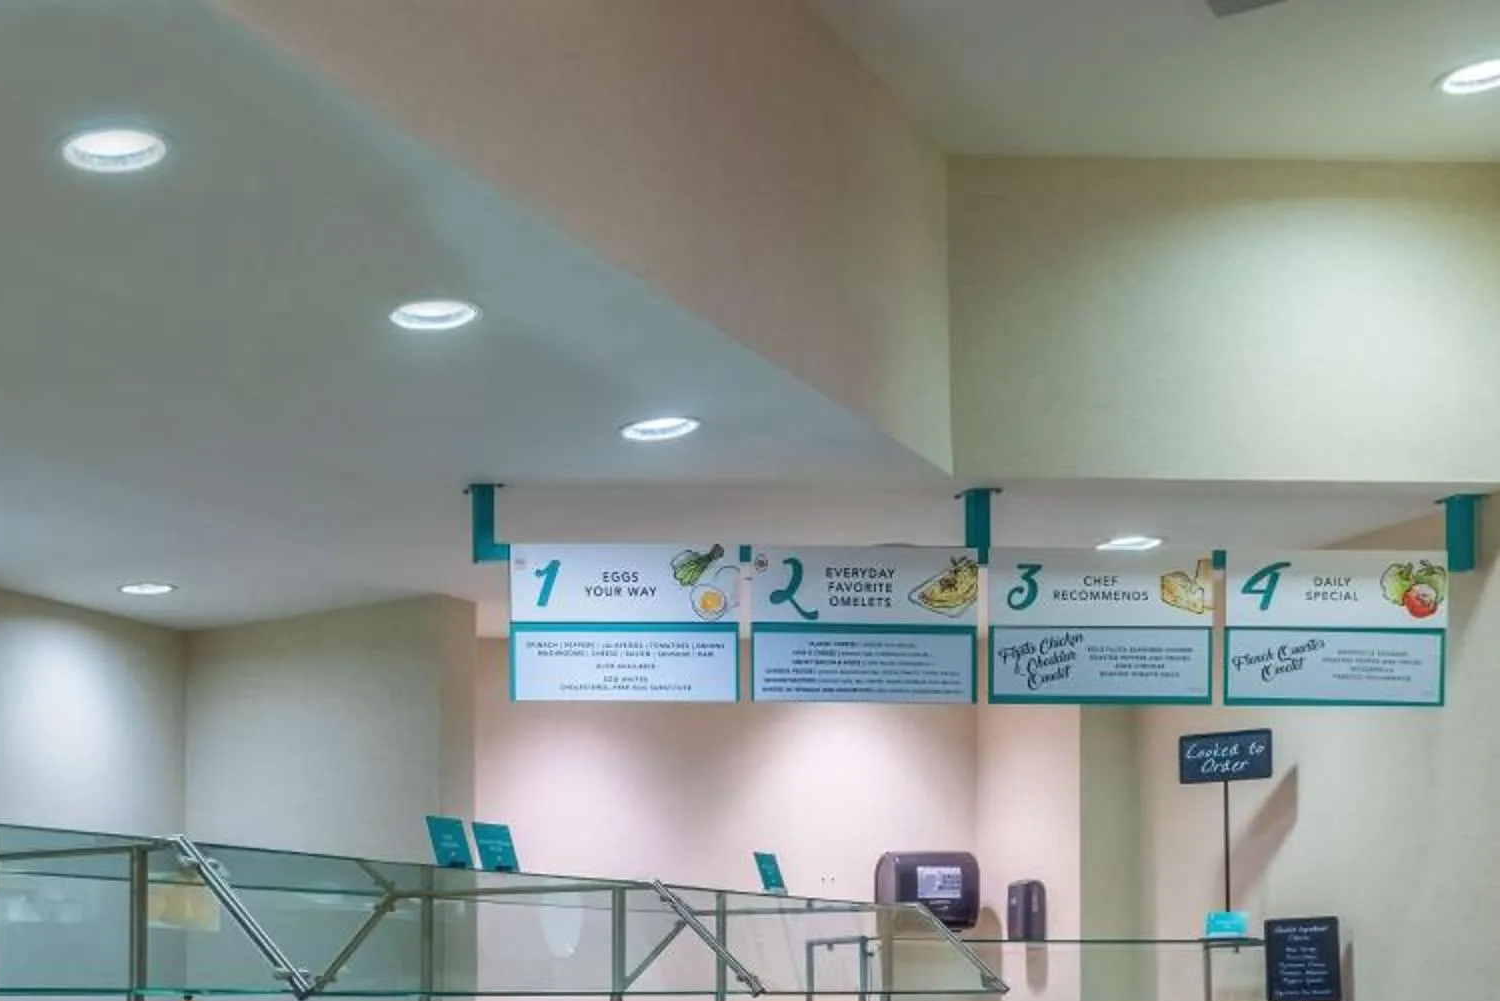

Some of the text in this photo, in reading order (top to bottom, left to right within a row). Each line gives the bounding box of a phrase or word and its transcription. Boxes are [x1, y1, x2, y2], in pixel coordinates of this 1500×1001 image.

[602, 571, 639, 583] EGGS
[825, 567, 896, 579] EVERYDAY
[535, 560, 561, 607] 1
[1007, 563, 1043, 611] 3
[1083, 575, 1119, 587] CHEF
[1241, 561, 1291, 611] 4
[1313, 576, 1352, 587] DAILY
[585, 586, 657, 598] YOUR WAY
[769, 557, 819, 620] 2
[827, 582, 893, 593] FAVORITE
[828, 596, 892, 608] OMELETS
[1053, 590, 1149, 602] RECOMMENDS
[1305, 591, 1359, 602] SPECIAL
[1249, 741, 1265, 755] to
[1201, 757, 1250, 773] Order
